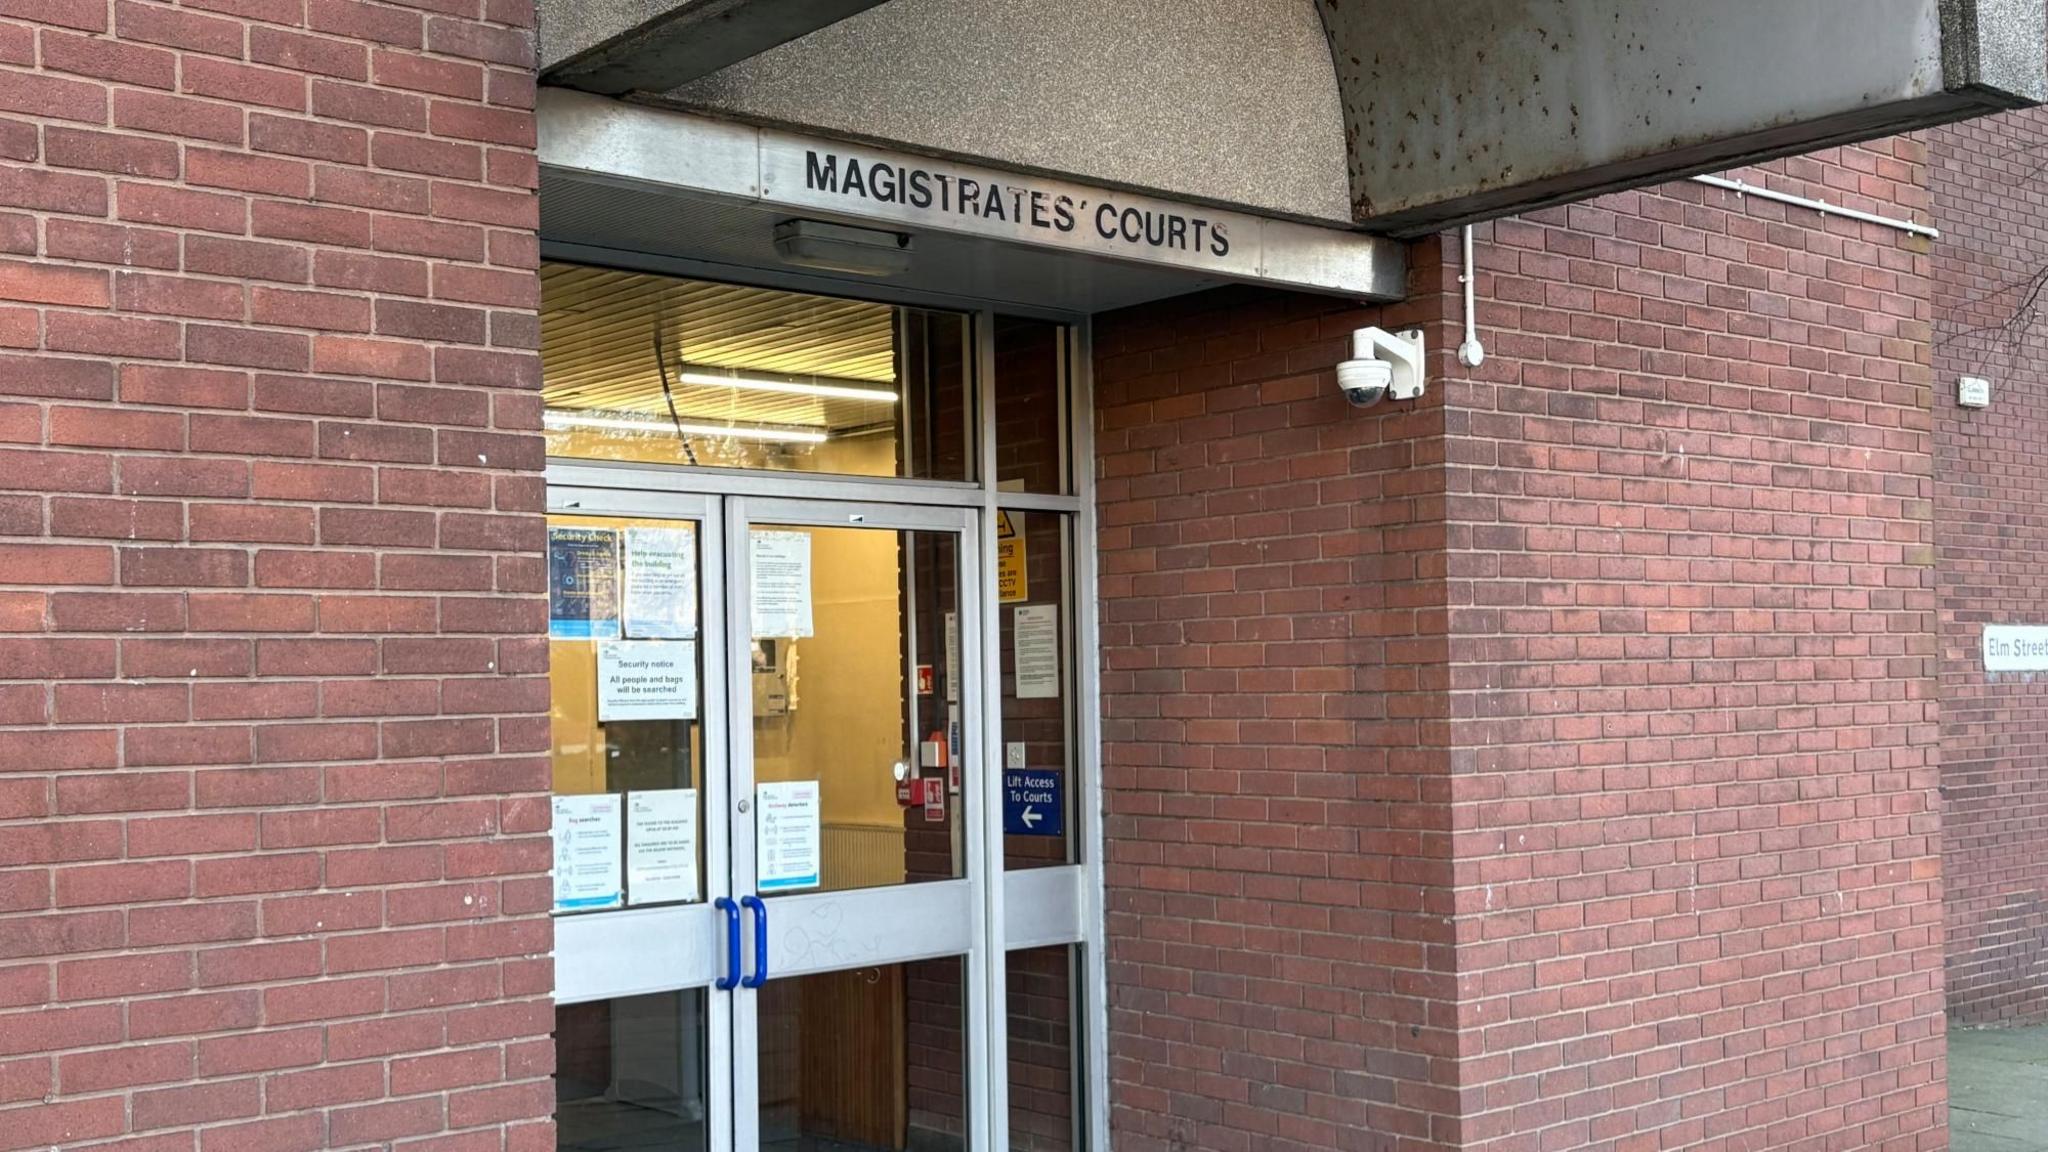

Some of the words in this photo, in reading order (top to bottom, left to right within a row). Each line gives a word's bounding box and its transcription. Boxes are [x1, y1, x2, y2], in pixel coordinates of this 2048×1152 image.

[805, 150, 1088, 233] MAGISTRATES'
[1095, 202, 1230, 258] COURTS
[550, 530, 587, 543] Security
[631, 549, 647, 559] Help
[644, 560, 672, 570] building
[1988, 637, 2010, 656] Elm
[618, 660, 649, 669] Security
[651, 660, 674, 669] notice
[610, 675, 621, 684] All
[622, 675, 648, 685] people
[649, 675, 664, 684] and
[665, 675, 684, 685] bags
[617, 686, 630, 694] will
[631, 686, 641, 694] be
[642, 685, 677, 694] searched
[1007, 775, 1022, 788] Lift
[1024, 775, 1055, 789] Access
[1010, 790, 1021, 803] To
[1023, 790, 1053, 803] Courts
